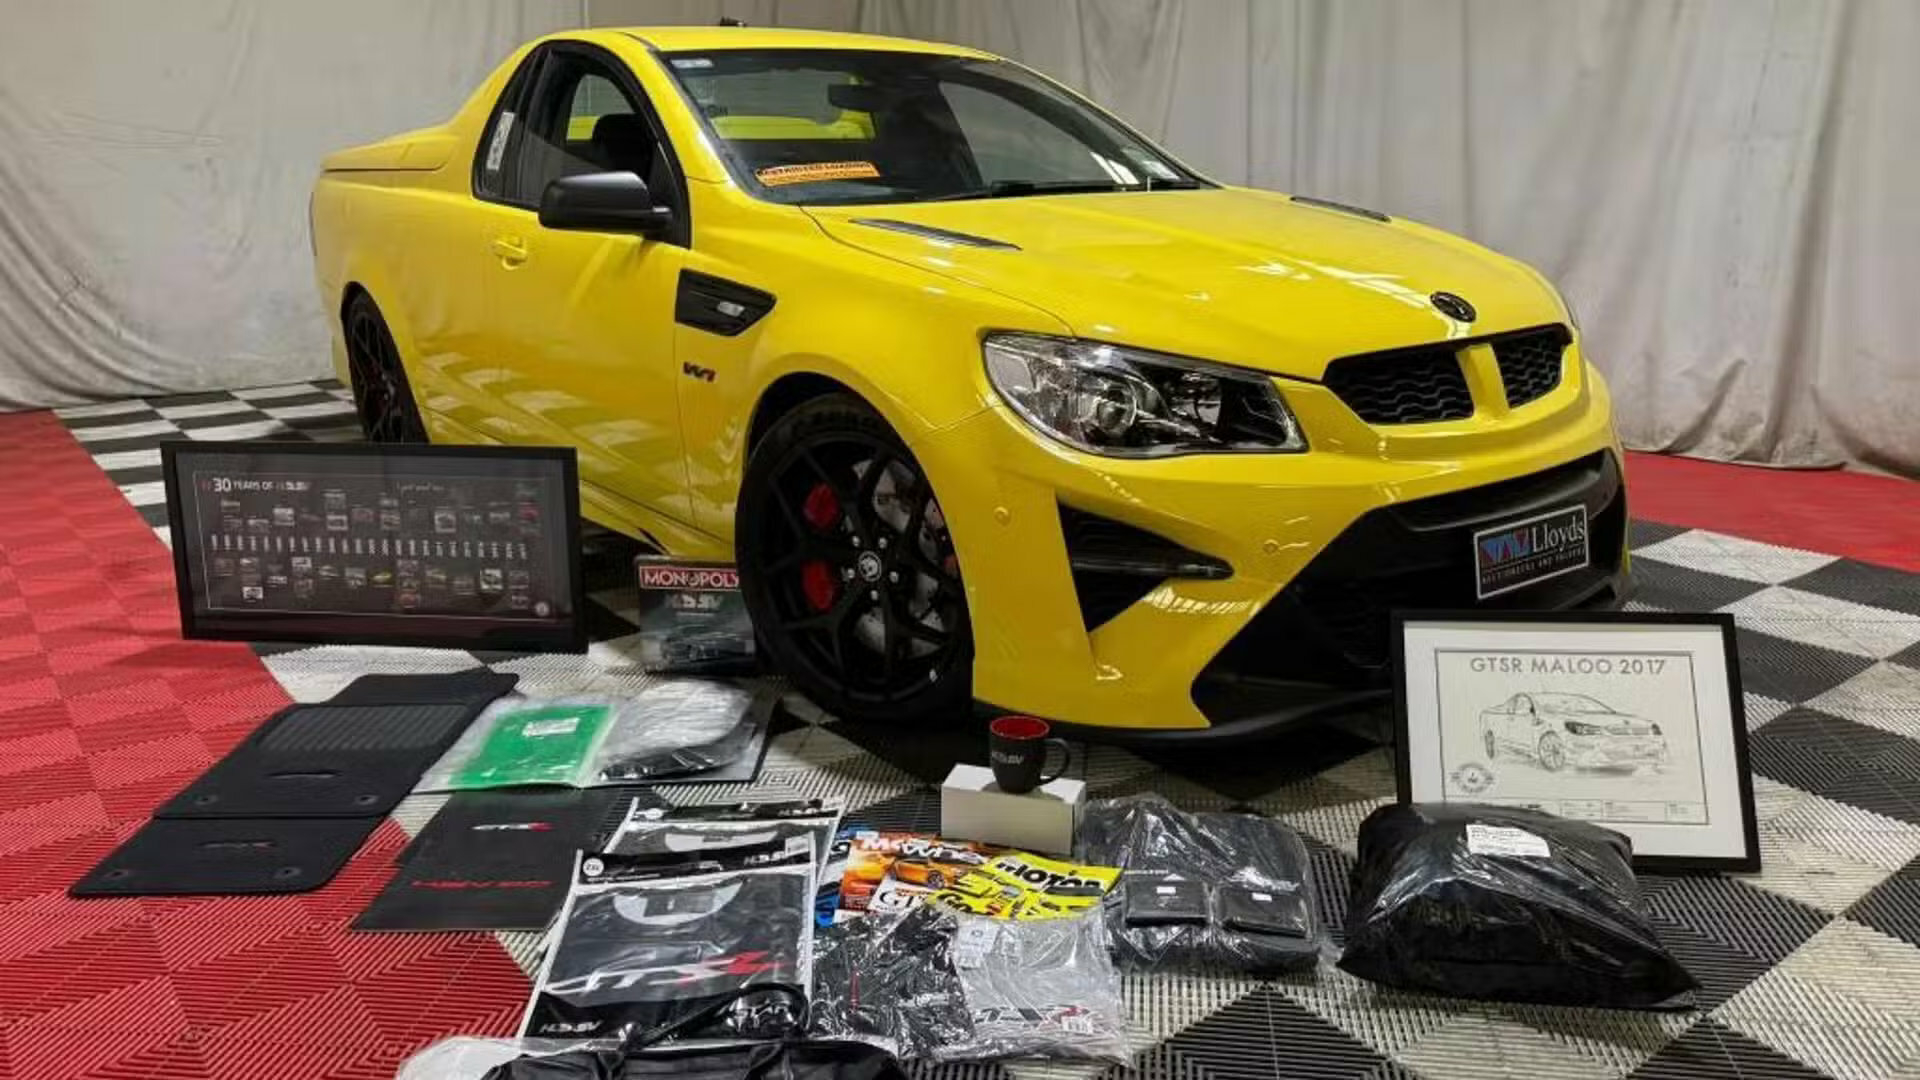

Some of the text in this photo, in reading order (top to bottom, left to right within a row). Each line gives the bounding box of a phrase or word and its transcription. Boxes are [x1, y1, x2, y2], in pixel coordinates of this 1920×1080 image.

[213, 477, 231, 492] 30
[1532, 515, 1585, 552] Lloyds
[644, 570, 739, 587] MONOPOLY
[1470, 657, 1665, 675] GTSR MALOO 2017
